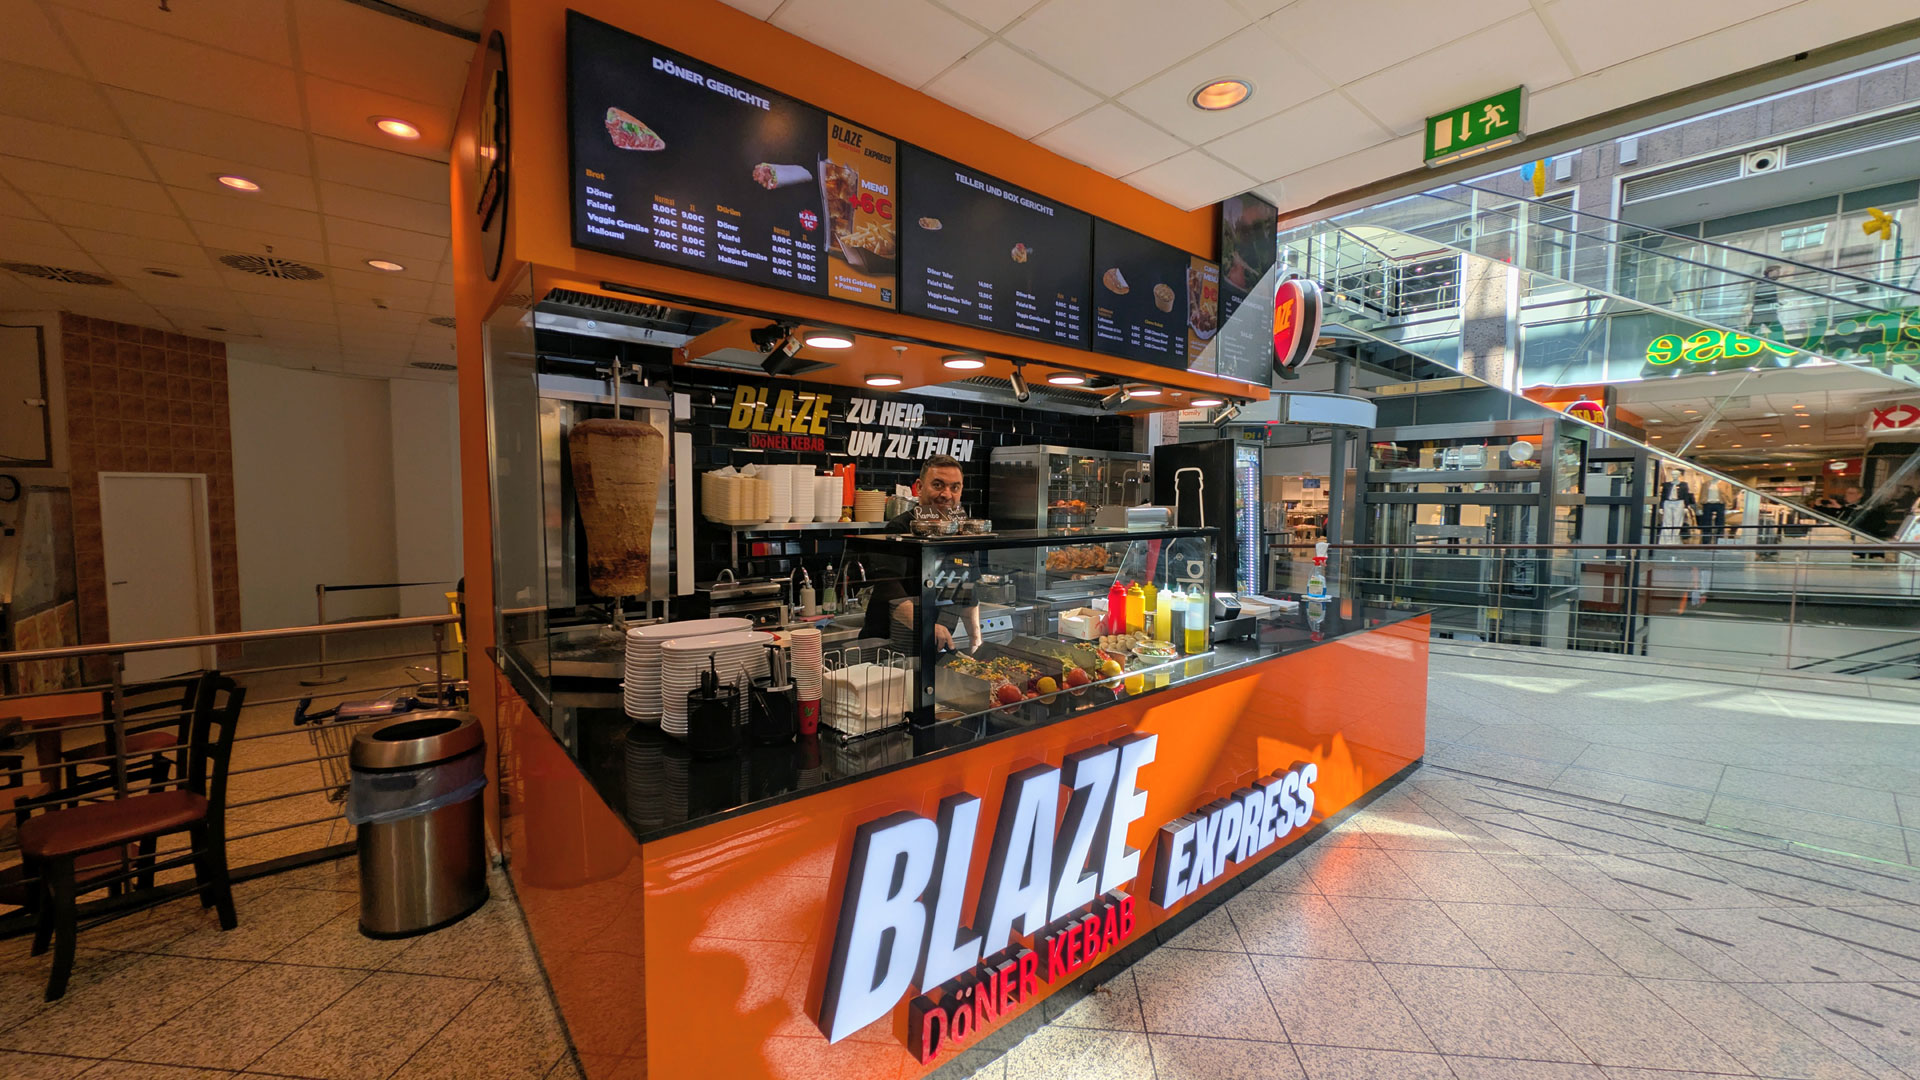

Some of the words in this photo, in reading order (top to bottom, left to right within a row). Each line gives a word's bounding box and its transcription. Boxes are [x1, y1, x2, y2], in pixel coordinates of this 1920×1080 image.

[653, 57, 704, 86] DÖNER
[706, 78, 770, 110] GERICHTE
[832, 125, 862, 148] BLAZE
[864, 148, 892, 164] EXPRESS
[586, 169, 605, 180] Brot
[586, 186, 613, 199] Döner
[861, 179, 888, 196] MENÜ
[955, 172, 984, 190] TELLER
[986, 184, 1002, 196] UND
[1003, 191, 1019, 203] BOX
[1020, 198, 1054, 216] GERICHTE
[587, 199, 615, 212] Falafel
[587, 212, 615, 225] Veggie
[616, 219, 649, 233] Gemüse
[587, 225, 624, 239] Halloumi
[717, 220, 739, 231] Döner
[718, 232, 740, 243] Falafel
[728, 384, 832, 435] BLAZE
[846, 397, 877, 424] ZU
[879, 400, 924, 428] HEIß
[790, 437, 824, 452] KEBAB
[847, 430, 883, 458] UM
[884, 433, 914, 460] ZU
[1163, 762, 1318, 909] EXPRESS
[831, 734, 1158, 1045] BLAZE
[1048, 893, 1136, 985] KEBAB
